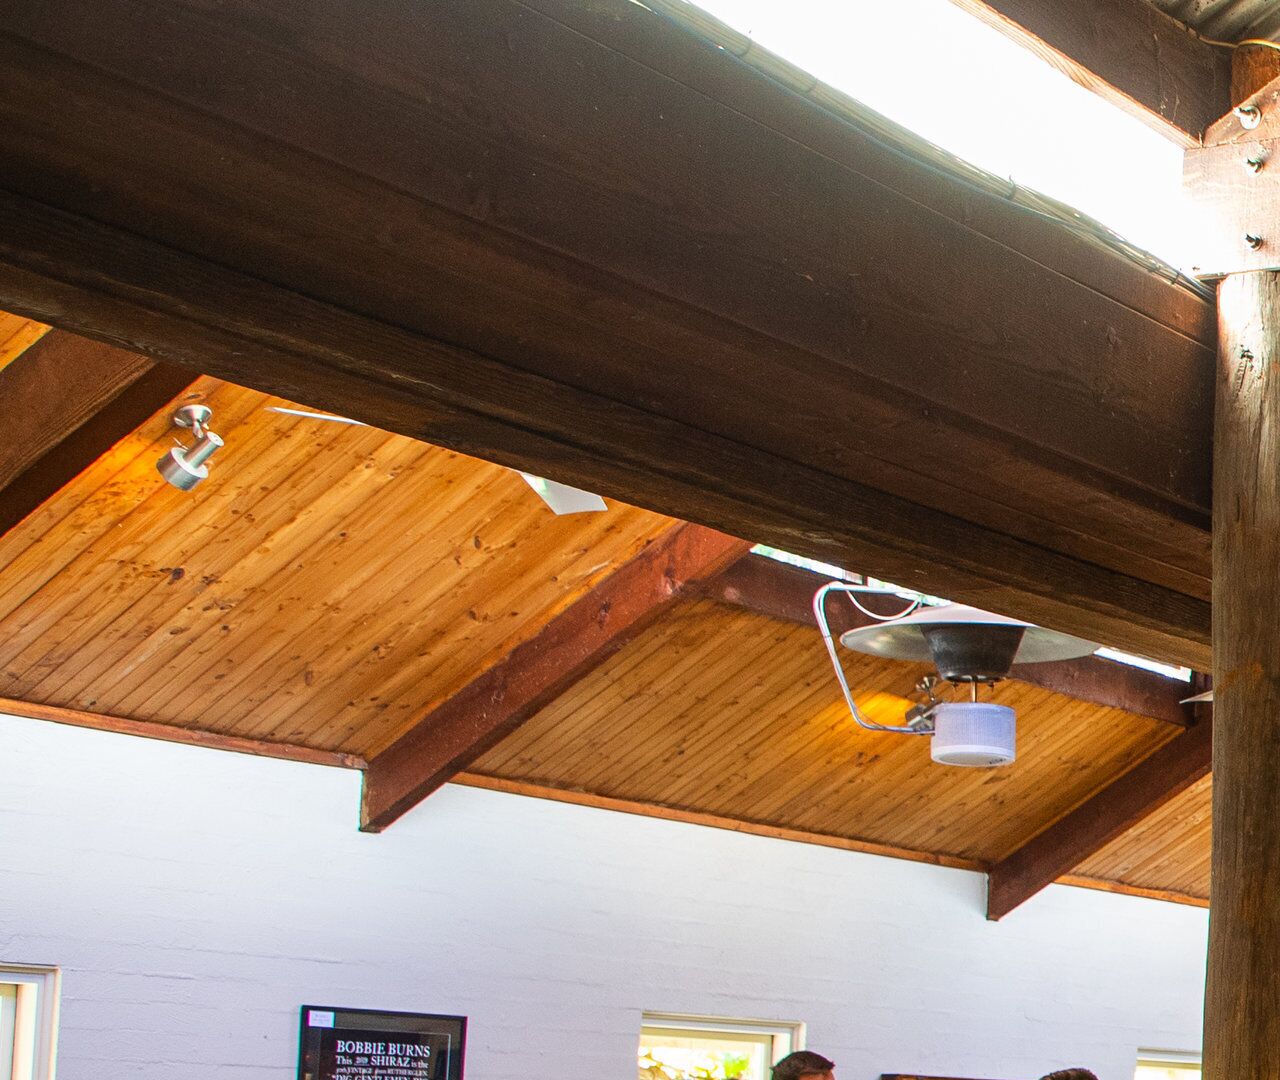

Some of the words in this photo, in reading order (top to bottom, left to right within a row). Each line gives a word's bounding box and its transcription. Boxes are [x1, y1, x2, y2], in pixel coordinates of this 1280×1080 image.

[336, 1040, 386, 1054] BOBBIE
[388, 1043, 431, 1057] BURNS
[335, 1055, 352, 1065] This
[371, 1056, 410, 1067] SHIRAZ
[418, 1060, 429, 1068] the
